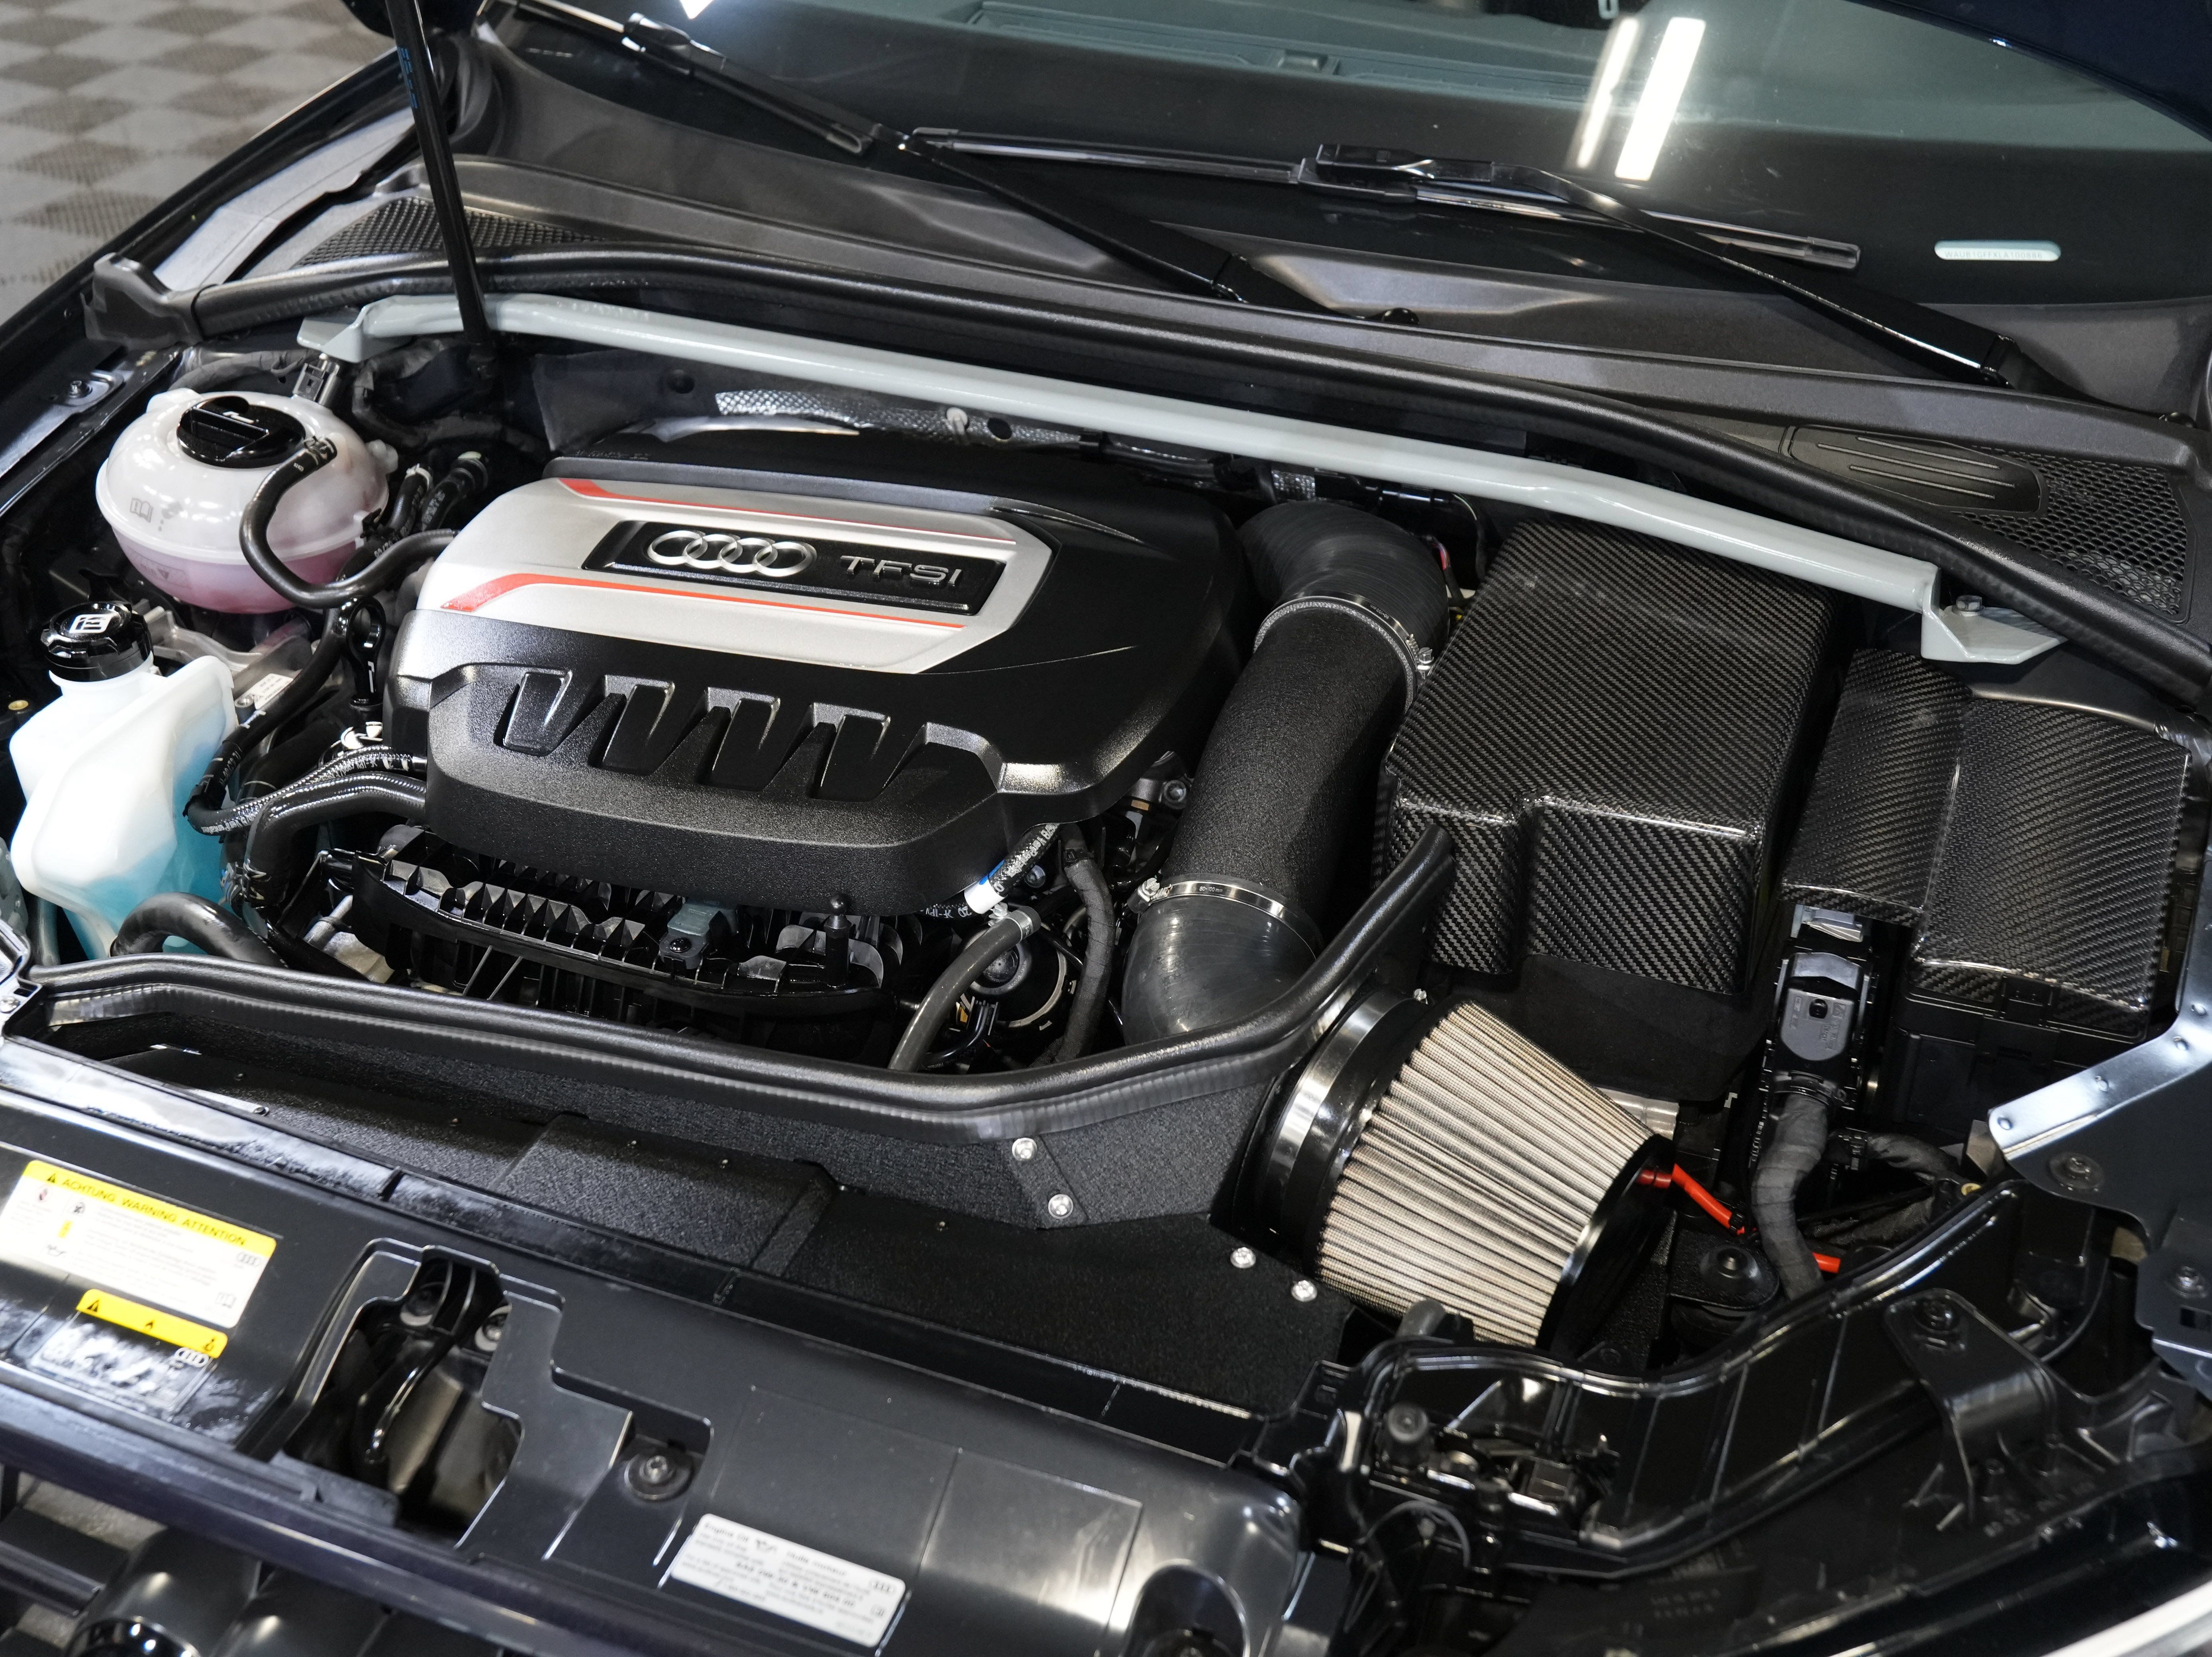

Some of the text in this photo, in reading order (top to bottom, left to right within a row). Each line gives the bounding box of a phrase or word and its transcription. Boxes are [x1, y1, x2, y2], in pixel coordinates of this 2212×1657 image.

[840, 555, 962, 586] TFSI
[62, 1179, 116, 1202] ACHTUNG
[122, 1199, 176, 1222] WARNING
[182, 1219, 246, 1246] ATTENTION
